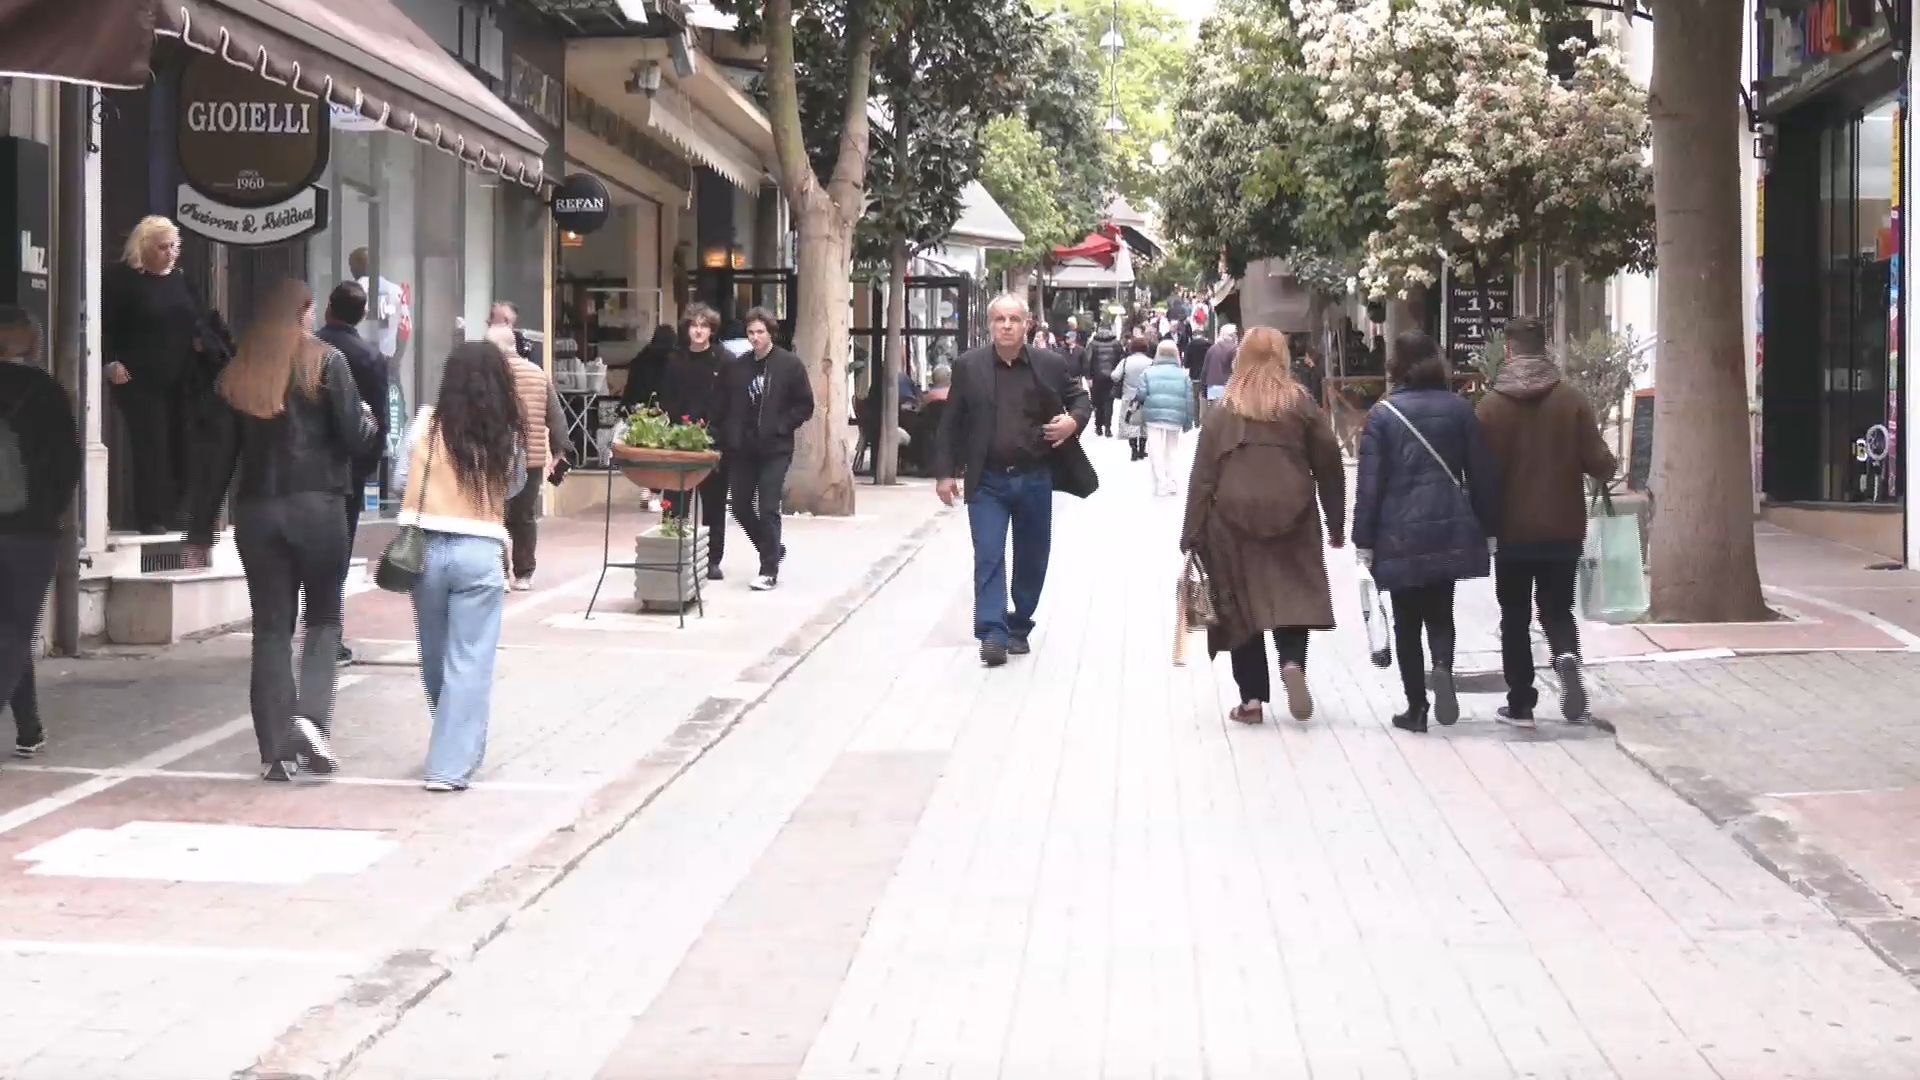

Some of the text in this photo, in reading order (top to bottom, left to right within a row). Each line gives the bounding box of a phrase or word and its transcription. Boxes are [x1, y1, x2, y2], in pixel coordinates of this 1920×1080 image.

[187, 101, 311, 134] GIOIELLI
[236, 177, 265, 190] 1960
[555, 197, 605, 209] REFAN
